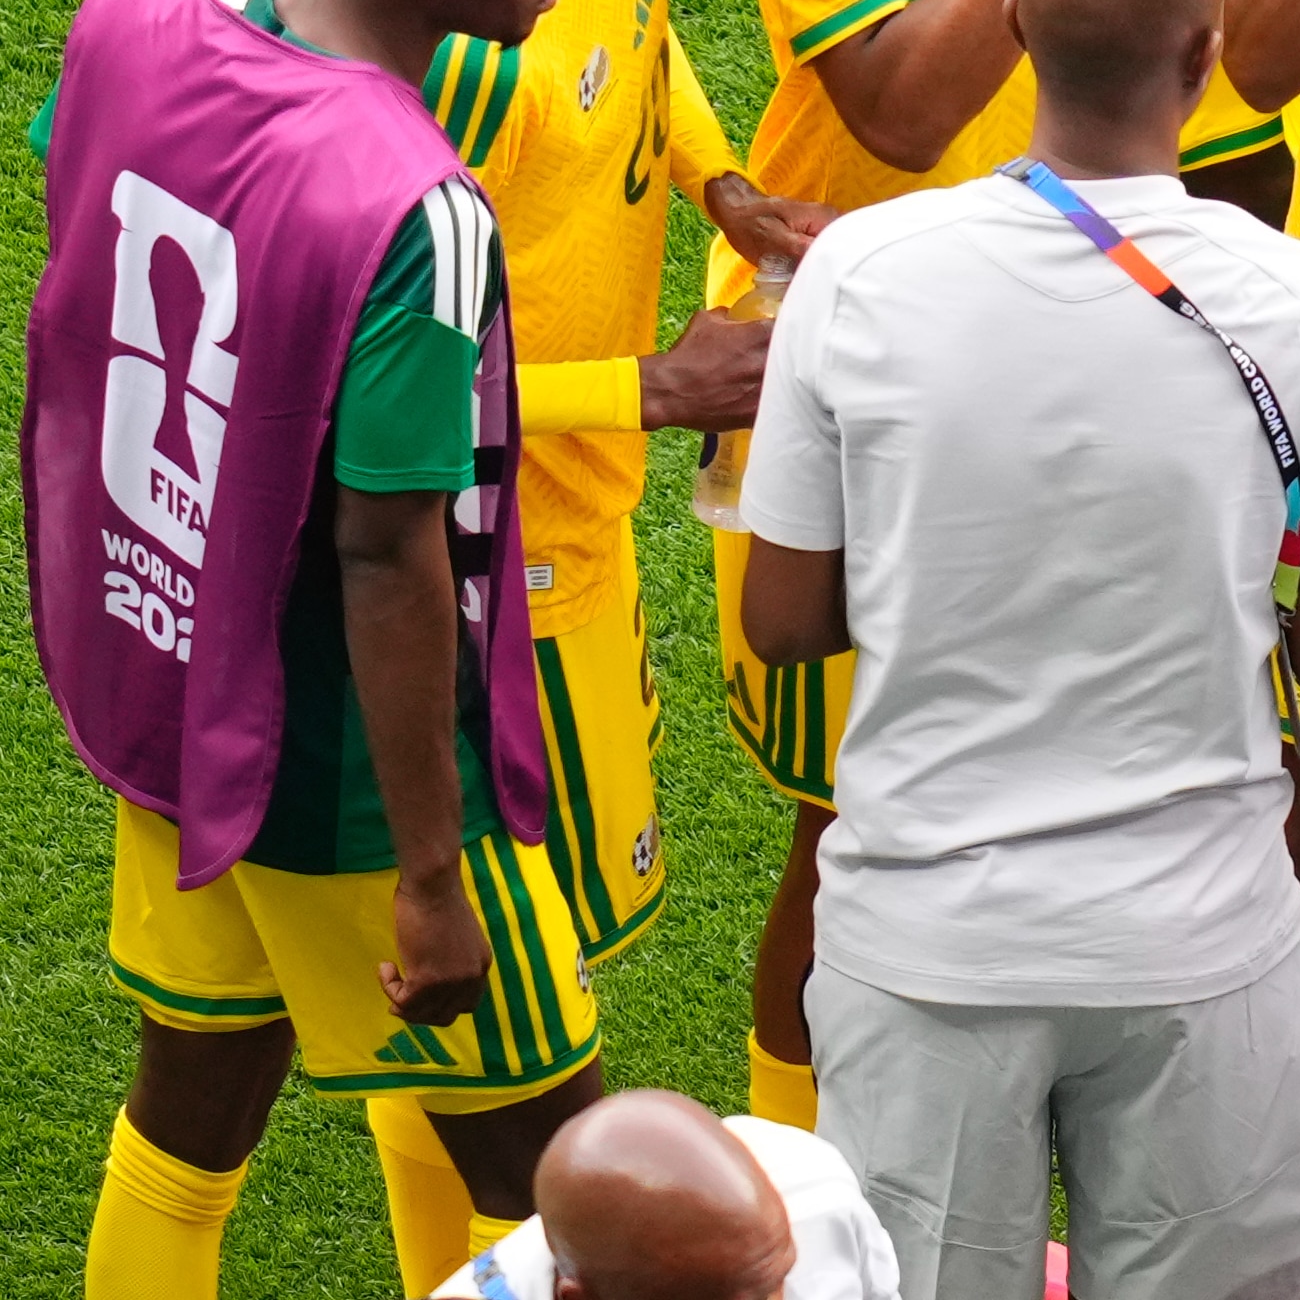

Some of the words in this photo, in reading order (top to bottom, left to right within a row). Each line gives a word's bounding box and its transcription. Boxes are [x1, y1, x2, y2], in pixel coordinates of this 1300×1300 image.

[1229, 345, 1257, 379] CUP
[1250, 376, 1284, 436] WORLD
[1275, 431, 1296, 468] FIFA
[150, 466, 207, 538] FIFA
[101, 528, 195, 607] WORLD
[104, 570, 195, 663] 202
